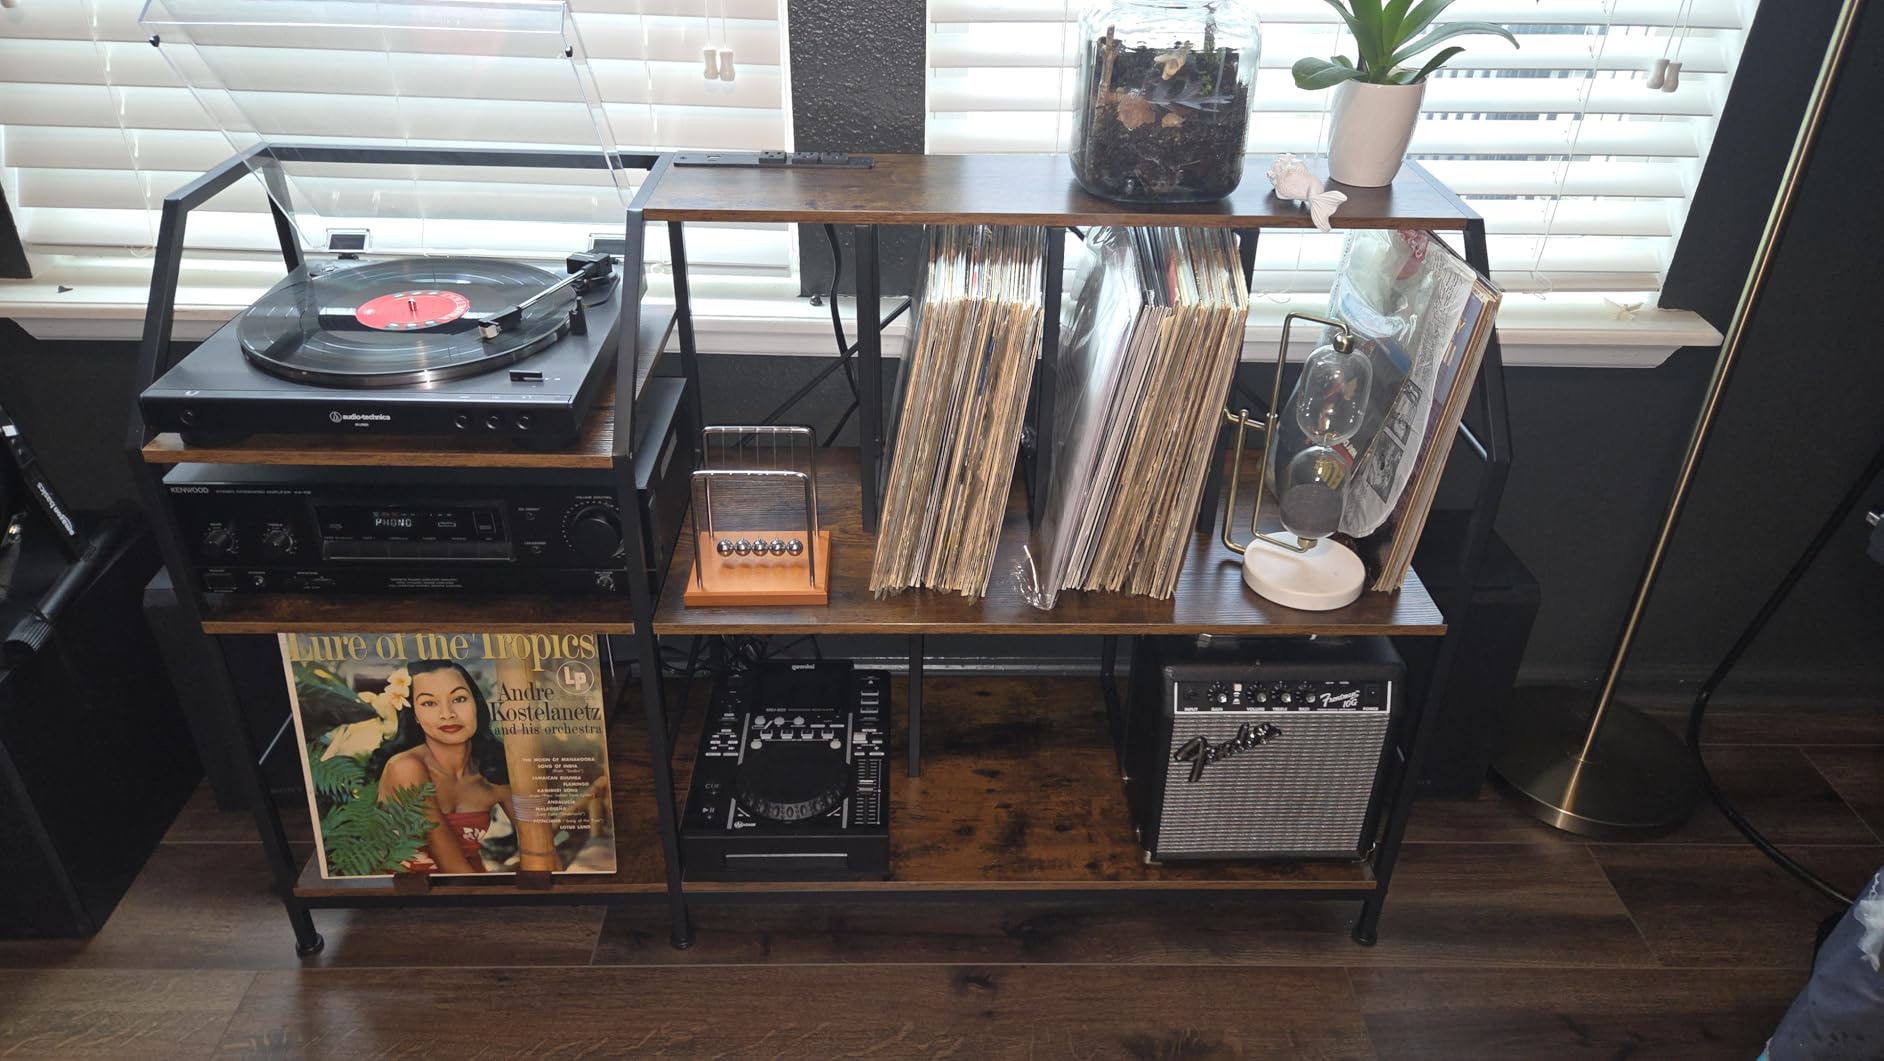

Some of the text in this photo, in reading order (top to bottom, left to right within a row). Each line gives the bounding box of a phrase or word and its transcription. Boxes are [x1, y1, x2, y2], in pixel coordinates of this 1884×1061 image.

[342, 413, 391, 421] audio-technica
[37, 481, 75, 536] amazon basics
[374, 518, 412, 528] PHONO
[287, 633, 596, 671] Lure of the Tropics
[791, 663, 816, 671] gemini
[498, 681, 554, 701] Andre
[488, 701, 602, 721] Kostelanetz
[1343, 698, 1358, 708] 10G
[494, 723, 602, 735] and his orchestra
[1174, 722, 1281, 782] Fender
